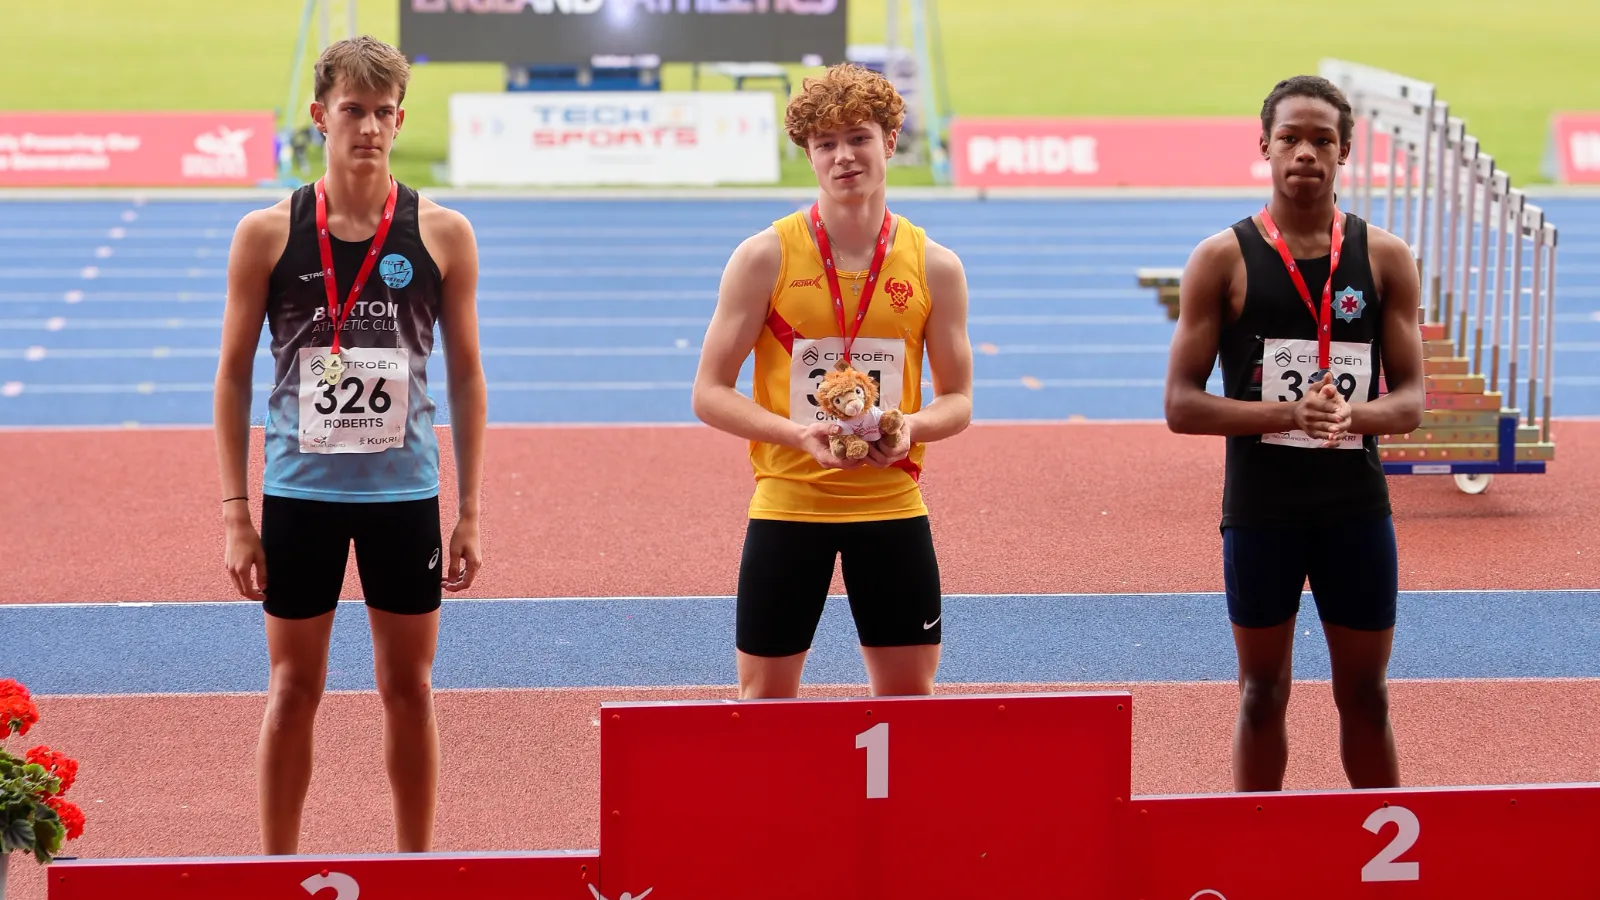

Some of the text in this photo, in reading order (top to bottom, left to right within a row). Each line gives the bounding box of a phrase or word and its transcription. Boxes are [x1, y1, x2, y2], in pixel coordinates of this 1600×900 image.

[532, 128, 698, 148] SPORTS
[968, 136, 1097, 173] PRIDE
[372, 319, 399, 331] CLU
[314, 376, 392, 415] 326
[806, 368, 881, 407] 31
[1278, 370, 1357, 403] 39
[324, 418, 384, 429] ROBERTS
[367, 436, 398, 445] KUKRI
[855, 722, 889, 799] 1
[1361, 805, 1420, 882] 2
